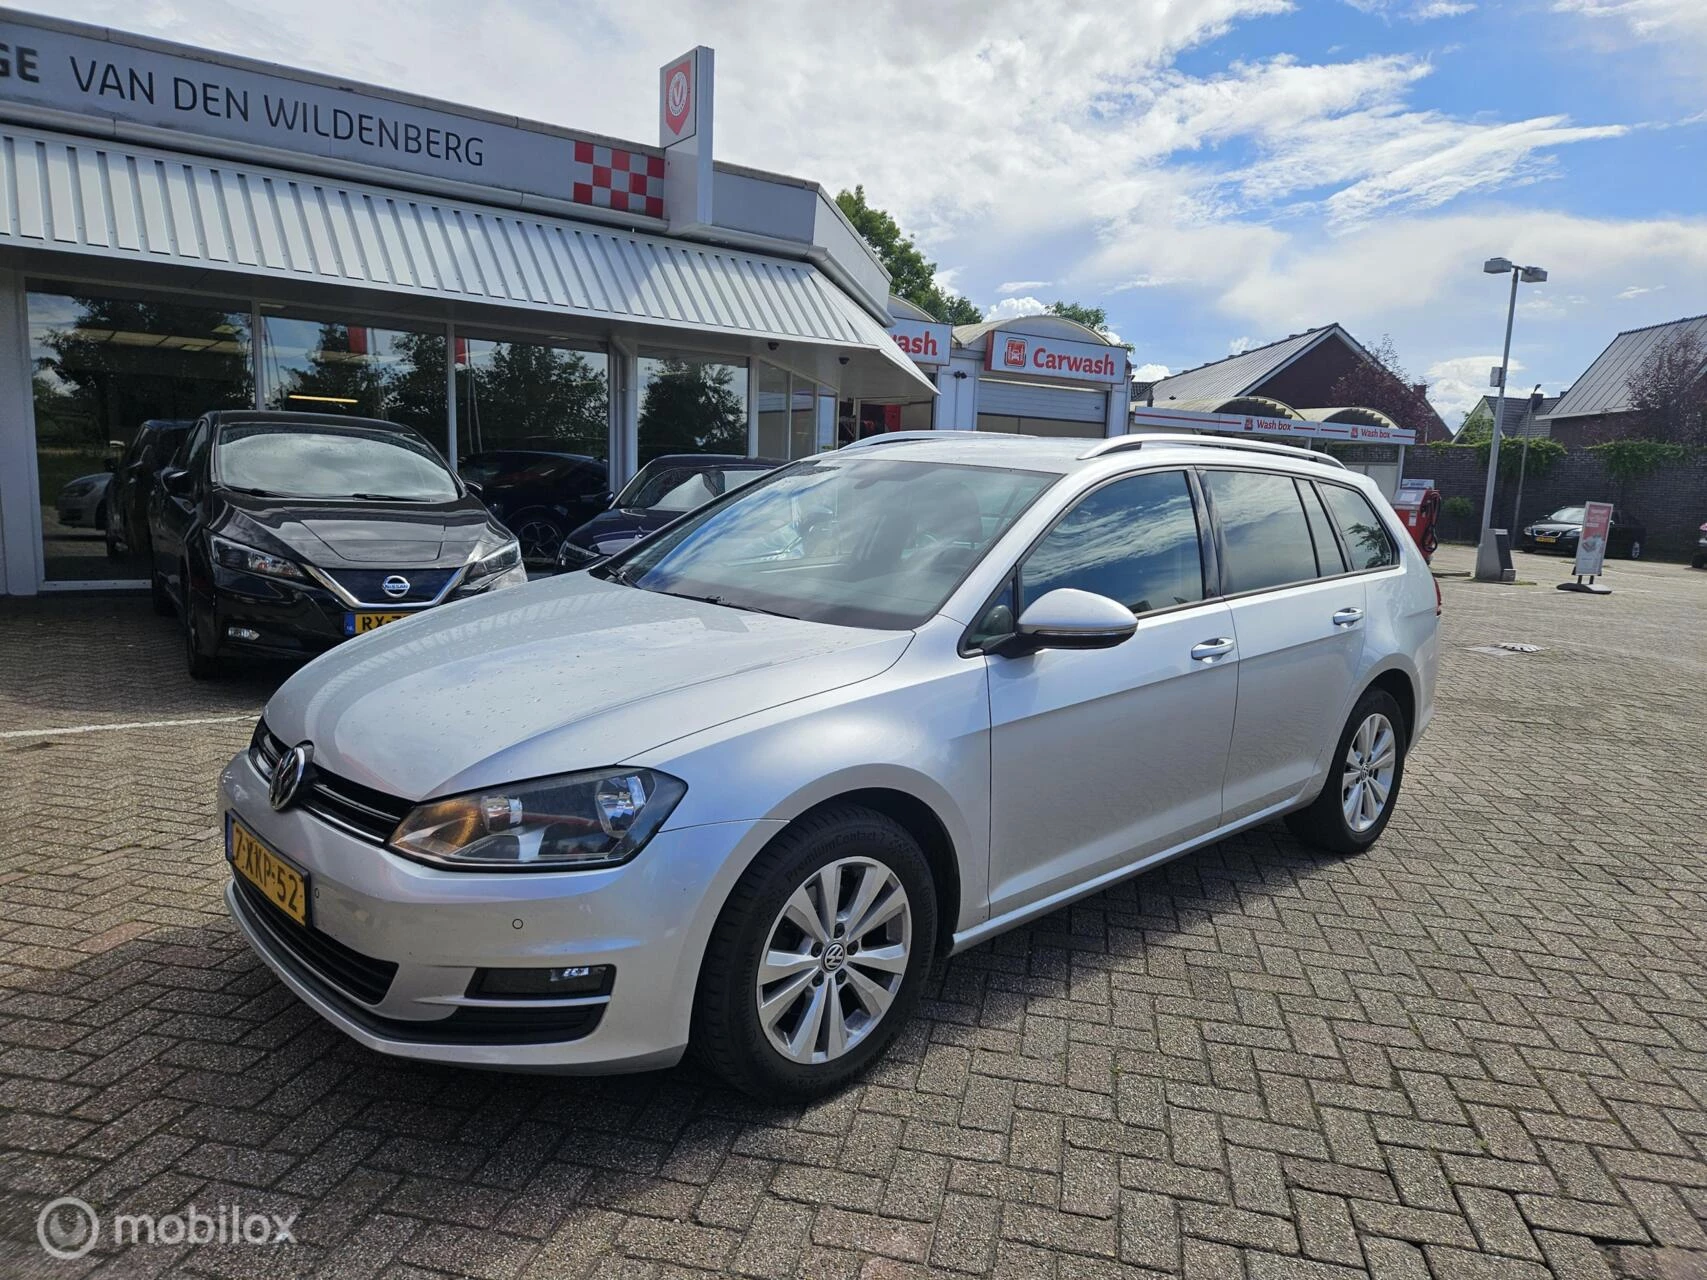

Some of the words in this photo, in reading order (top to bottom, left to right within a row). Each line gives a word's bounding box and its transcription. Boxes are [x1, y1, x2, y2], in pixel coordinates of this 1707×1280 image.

[69, 56, 155, 105] VAN
[173, 77, 249, 122] DEN
[264, 95, 485, 167] WILDENBERG
[892, 331, 938, 356] ash
[1033, 347, 1115, 376] Carwash
[1256, 419, 1277, 430] Wash
[1278, 421, 1291, 431] box
[1361, 428, 1378, 438] Wash
[1379, 430, 1390, 438] box
[362, 616, 407, 630] RX-
